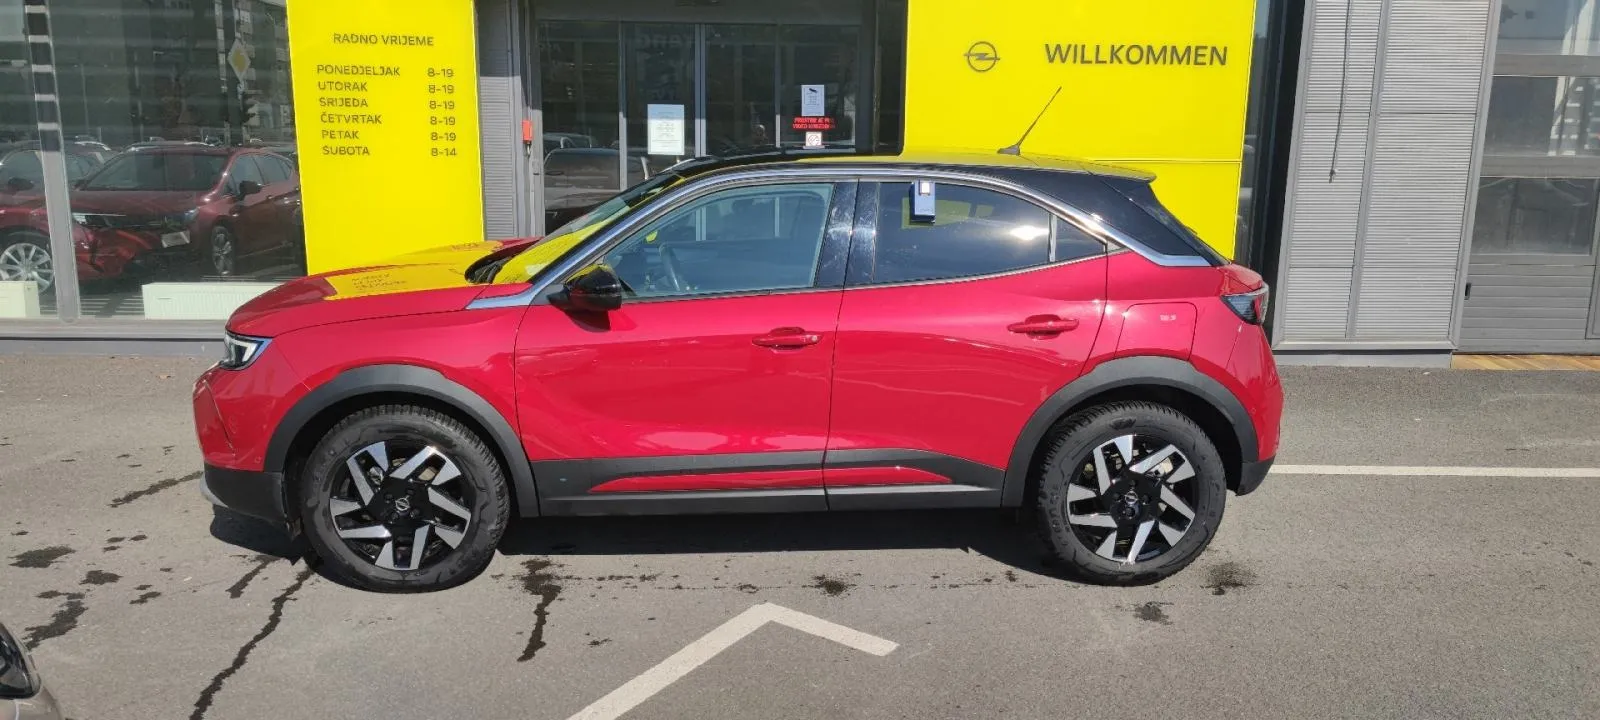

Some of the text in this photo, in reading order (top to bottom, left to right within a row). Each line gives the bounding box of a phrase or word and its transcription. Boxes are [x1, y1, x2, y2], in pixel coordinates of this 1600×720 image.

[333, 32, 434, 46] RADNO VRIJEME
[1044, 43, 1228, 67] WILLKOMMEN
[316, 64, 454, 78] PONEDJELJAK 8-19
[318, 80, 455, 95] UTORAK 8-19
[319, 97, 455, 110] SRIJEDA 8-19
[320, 111, 456, 126] ČETVRTAK 8-19
[321, 130, 457, 142] PETAK 8-19
[322, 145, 457, 157] SUBOTA 8-14
